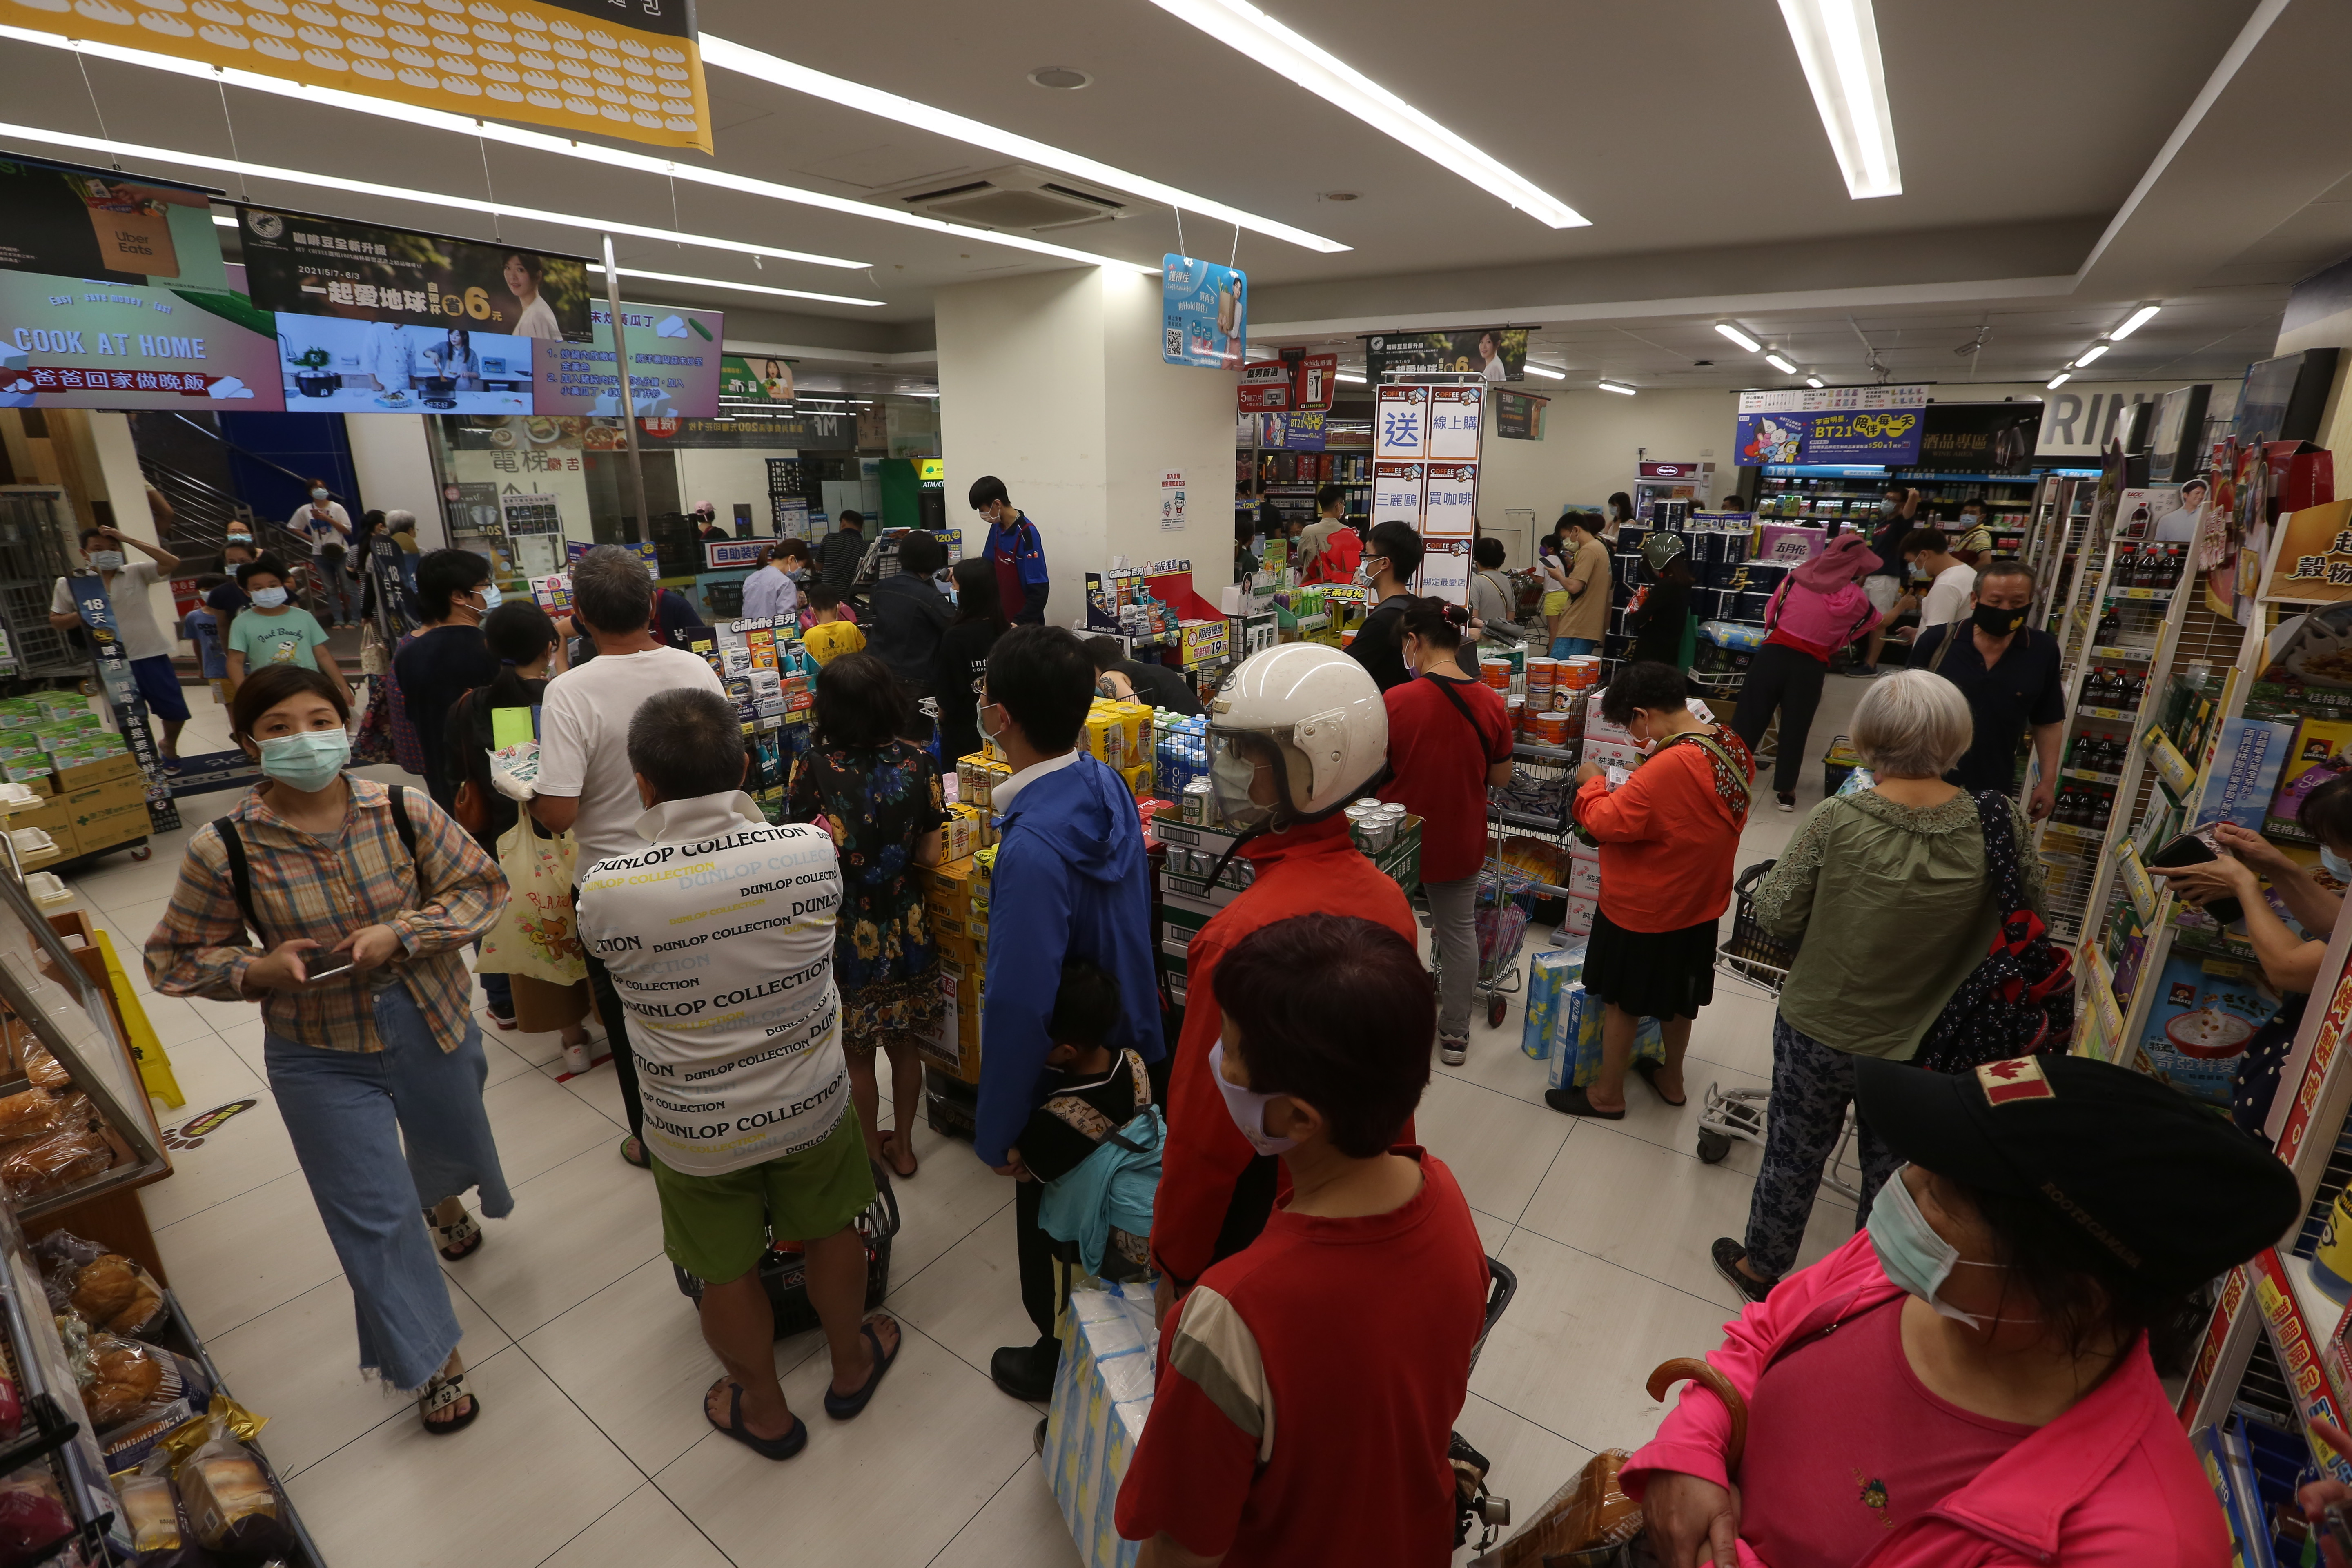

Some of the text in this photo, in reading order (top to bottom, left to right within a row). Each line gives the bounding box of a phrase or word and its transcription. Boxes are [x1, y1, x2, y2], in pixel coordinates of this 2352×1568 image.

[115, 230, 149, 244] Uber
[292, 231, 387, 256] 咖啡豆全新升級
[119, 242, 153, 256] Eats
[1168, 270, 1190, 283] 護得住
[84, 292, 108, 303] save
[111, 294, 143, 308] money
[301, 281, 428, 313] 一起愛地球
[445, 295, 462, 314] 省
[464, 286, 491, 320] 6
[1200, 291, 1215, 305] 買再多
[492, 310, 503, 322] 元
[13, 327, 208, 360] COOK AT HOME
[1386, 342, 1424, 350] 咖啡豆全新升級
[561, 361, 590, 373] 金黃色
[1247, 367, 1280, 379] 型男首選
[31, 368, 208, 392] 爸爸回家做晚飯
[1290, 418, 1304, 428] BT21
[1432, 415, 1478, 431] 線上購
[1815, 415, 1845, 426] 宇宙明星
[1384, 411, 1419, 448] 送
[1815, 425, 1853, 438] BT21
[1923, 433, 1988, 450] 酒品專區
[490, 450, 550, 474] 電梯
[1773, 467, 1796, 476] 飲料
[1376, 492, 1417, 508] 三麗鷗
[1428, 491, 1472, 506] 買咖啡
[717, 544, 775, 561] 自助裝袋
[1775, 542, 1808, 555] 五月花
[388, 565, 400, 582] 18
[1109, 567, 1143, 579] Gillette 吉列
[1154, 559, 1178, 572] 新品推薦
[2287, 557, 2352, 584] 穀物
[1423, 577, 1466, 588] 綁定最愛店
[1728, 566, 1755, 591] 厚
[1321, 588, 1365, 599] 午茶時光
[83, 598, 105, 611] 18
[91, 612, 106, 624] 天
[731, 617, 773, 633] Gillette
[774, 612, 796, 626] 吉列
[257, 627, 305, 644] Just Beachy
[1198, 623, 1224, 640] 限時優惠
[102, 646, 122, 671] 啤酒
[2125, 652, 2141, 661] 紅茶
[2307, 692, 2352, 706] 桂格穀
[762, 758, 777, 768] Gillette
[1598, 757, 1633, 768] 純濃燕
[2303, 752, 2328, 760] QUAKER
[1172, 767, 1180, 794] ZICO
[592, 827, 809, 873] DUNLOP COLLECTION
[941, 825, 949, 861] 一番搾り
[583, 861, 715, 893] DUNLOP COLLECTION
[740, 869, 837, 897] DUNLOP COLLECTIO
[1225, 882, 1241, 890] BEER
[653, 933, 708, 954] DUNLOP
[711, 915, 791, 941] COLLECTION
[624, 953, 831, 1018] DUNLOP COLLECTION
[626, 977, 700, 991] COLLECTION
[2169, 996, 2192, 1005] QUAKER
[2222, 993, 2271, 1016] さくさく
[684, 1038, 810, 1082] DUNLOP COLLECTION
[2156, 1053, 2241, 1073] 奇亞籽麥
[655, 1071, 844, 1140] DUNLOP COLLECTION
